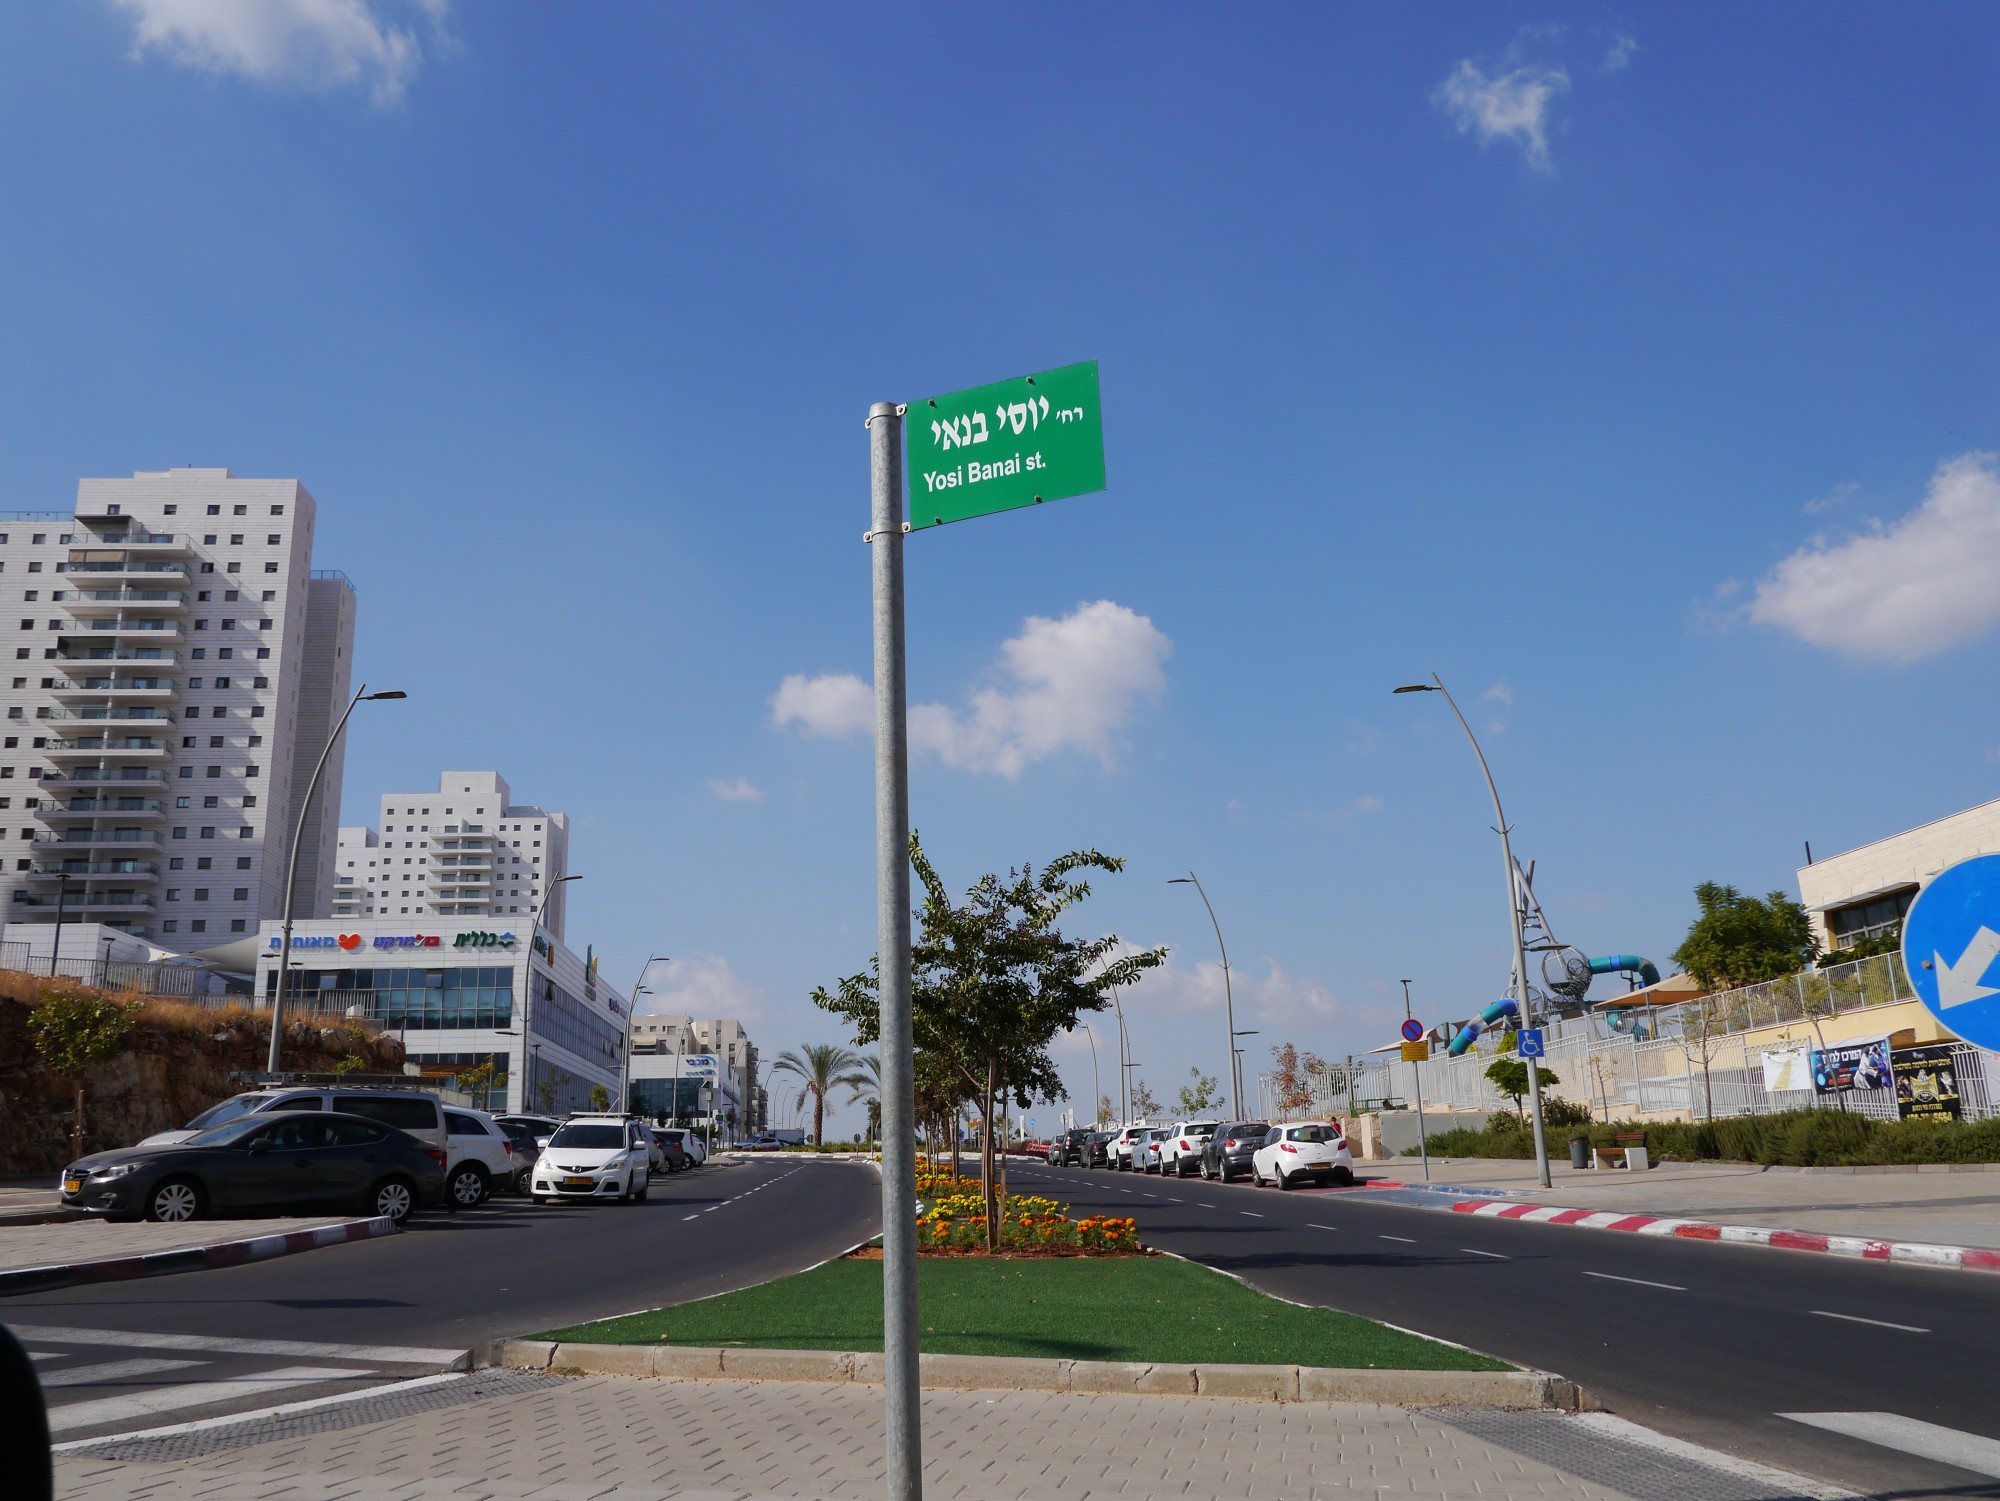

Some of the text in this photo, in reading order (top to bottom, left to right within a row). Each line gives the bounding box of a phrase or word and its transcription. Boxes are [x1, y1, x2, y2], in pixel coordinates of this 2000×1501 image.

[930, 409, 990, 451] בנאי
[995, 394, 1050, 435] יוסי
[923, 450, 1046, 492] Yosi Banai st.
[268, 936, 336, 949] מאוחת
[452, 930, 498, 948] כללית
